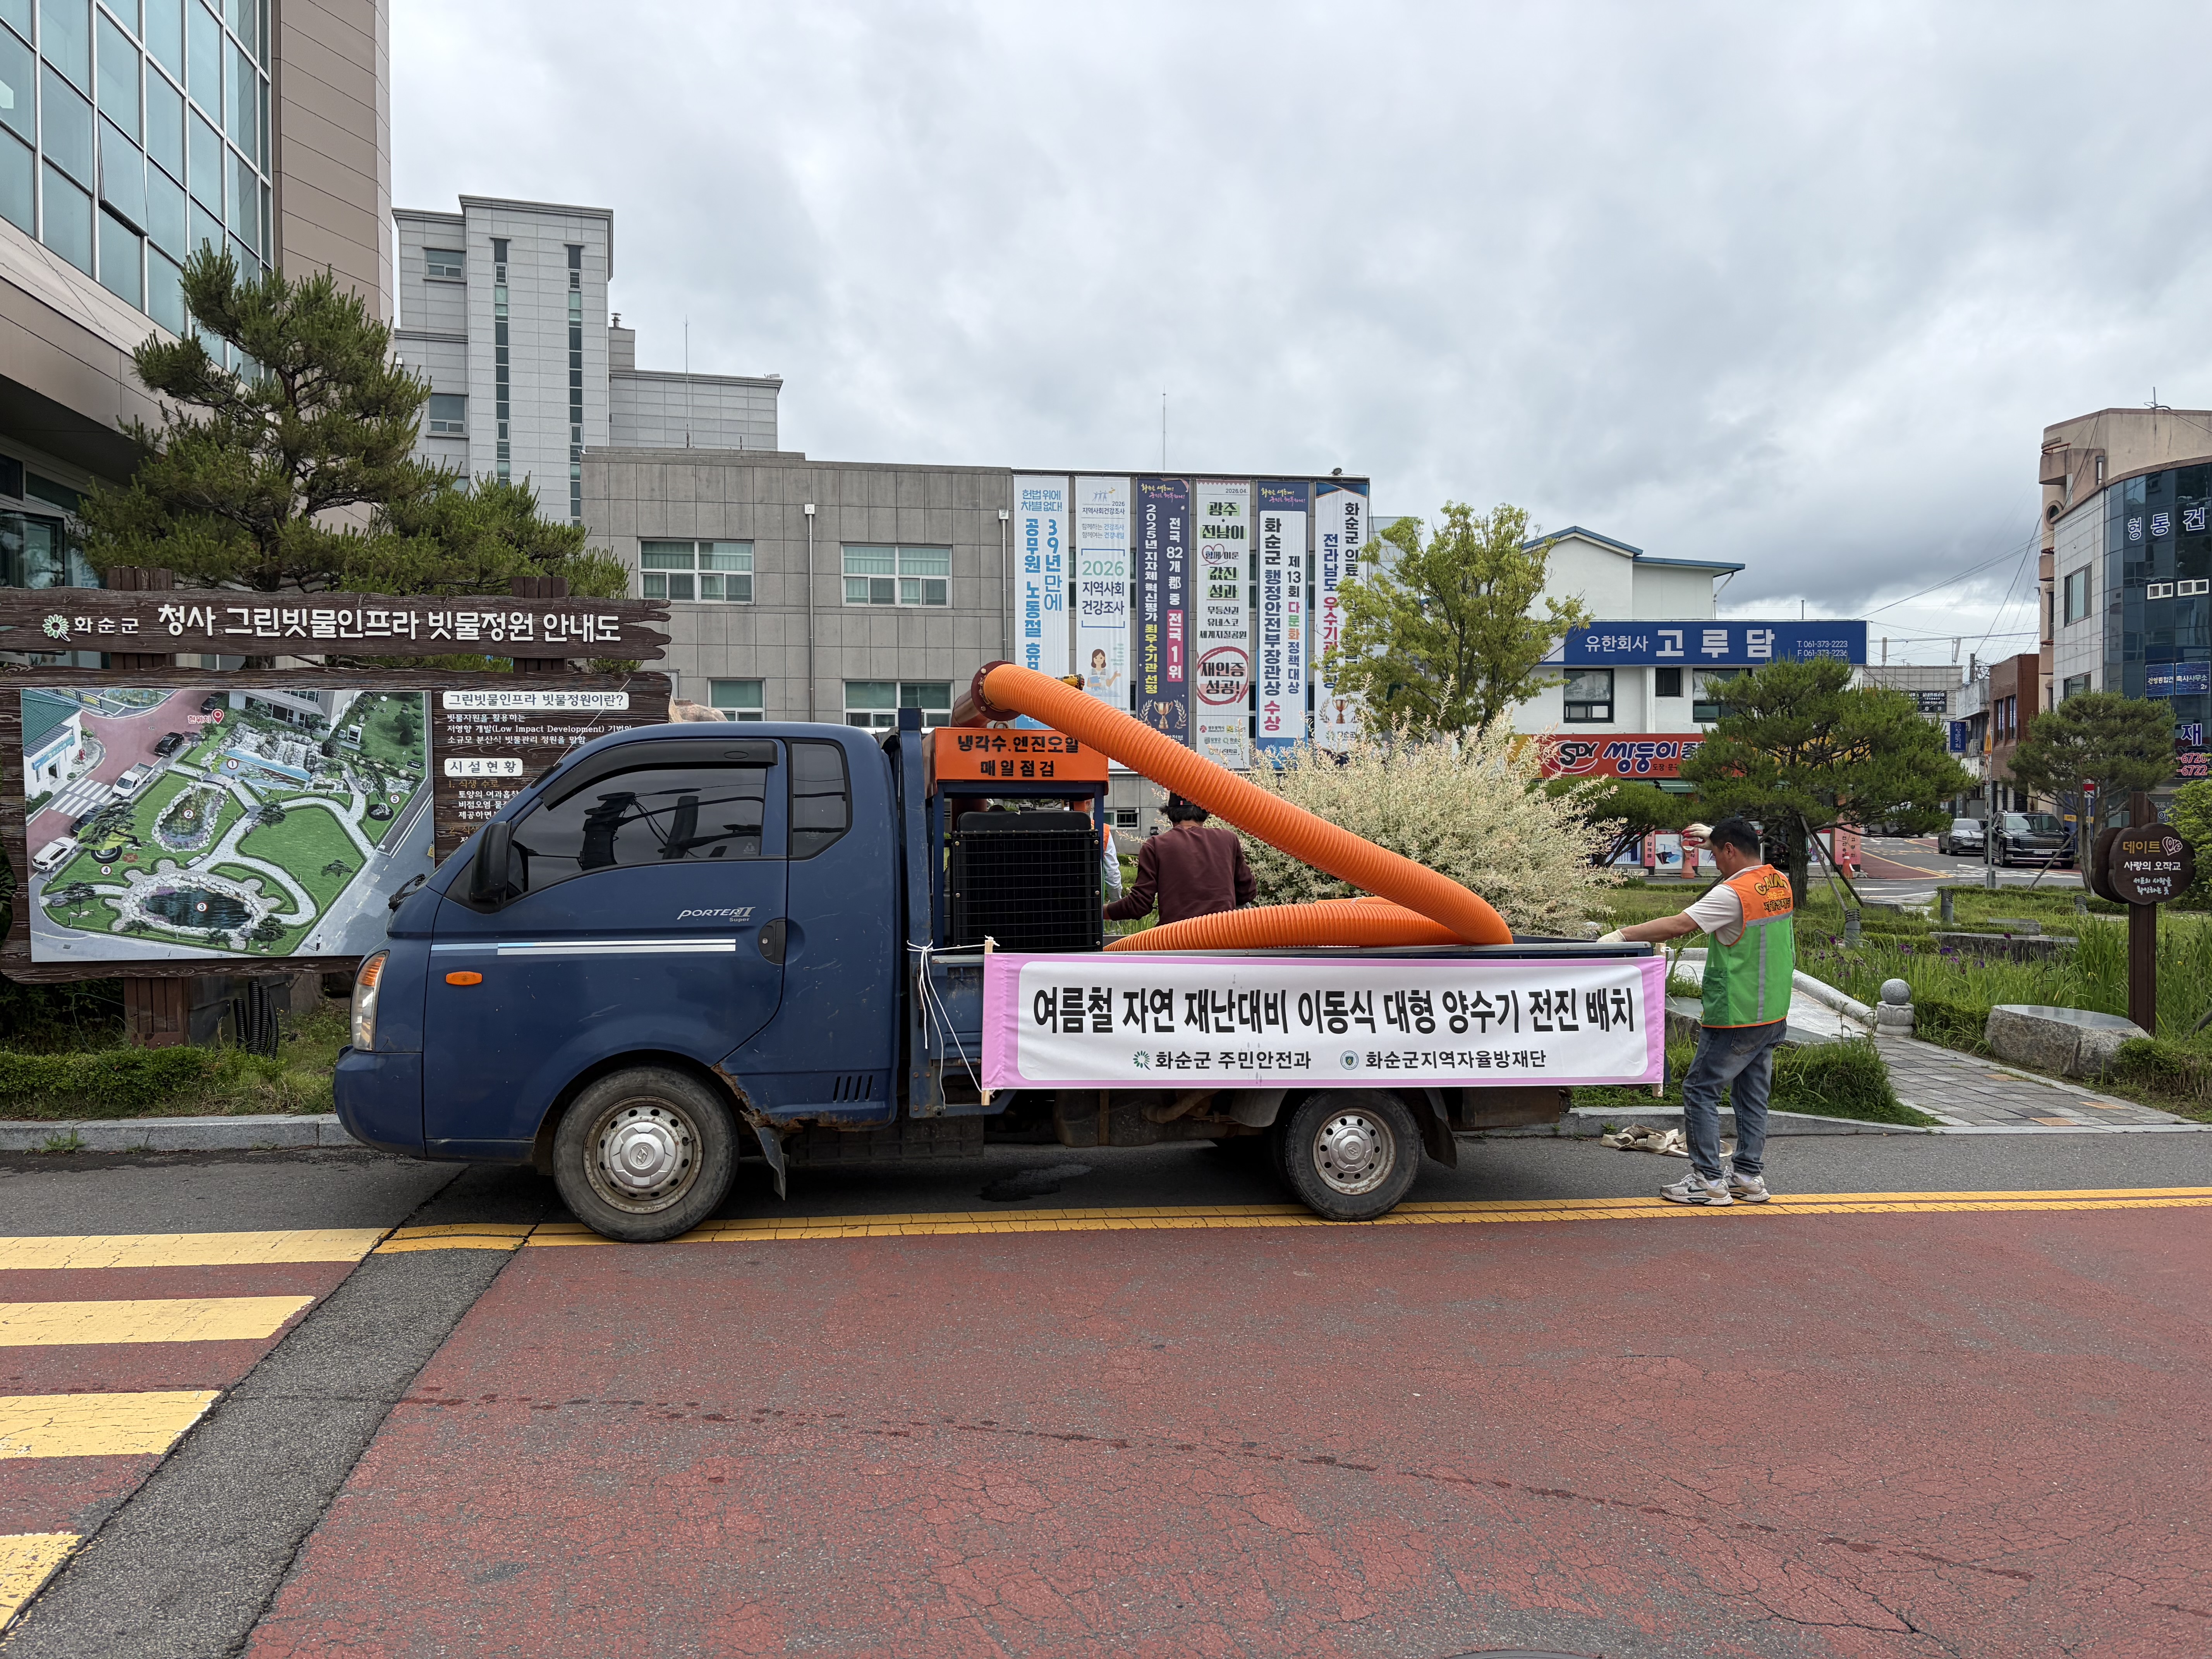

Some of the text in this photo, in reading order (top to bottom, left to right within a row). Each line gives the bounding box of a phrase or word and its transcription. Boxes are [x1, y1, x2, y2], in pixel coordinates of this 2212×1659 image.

[1022, 489, 1061, 500] 헌법 위에
[1021, 501, 1062, 511] 차별 없다!
[1209, 502, 1238, 516] 광주
[1345, 502, 1359, 544] 화순군
[1170, 518, 1180, 543] 전국
[1202, 525, 1244, 539] 전남이
[1025, 519, 1040, 573] 공무원
[1205, 551, 1220, 559] 함께
[1082, 560, 1124, 576] 2026
[1145, 552, 1158, 581] 지자체
[1324, 534, 1339, 591] 전라남도
[1209, 567, 1237, 580] 값진
[1083, 581, 1124, 596] 지역사회
[1209, 585, 1237, 598] 성과
[1145, 583, 1158, 622] 혁신평가
[1170, 593, 1180, 605] 중
[1025, 581, 1041, 637] 노동절
[1082, 600, 1124, 615] 건강조사
[1207, 606, 1239, 615] 무등산권
[74, 604, 621, 643] 화순군 청사 그린빗물인프라 빗물정원 안내도
[1169, 613, 1181, 641] 전국
[1207, 618, 1239, 627] 유네스코
[1264, 517, 1281, 731] 화순군 행정안전부장관상 수상
[1199, 630, 1247, 639] 세계지질공원
[1145, 624, 1158, 672] 최우수기관
[1585, 635, 1649, 652] 유한회사
[1201, 662, 1245, 677] 재인증
[1145, 675, 1158, 694] 선정
[1206, 680, 1240, 694] 성공!
[448, 694, 624, 707] 그린빗물인프라 빗물정원이란?
[187, 715, 211, 724] 현위치
[447, 725, 472, 733] 저영향
[515, 725, 544, 733] Impact
[447, 736, 473, 744] 소규모
[476, 736, 501, 744] 분산식
[505, 736, 538, 744] 빗물관리
[1559, 742, 1599, 766] SDY
[1602, 741, 1678, 773] 쌍둥이
[459, 780, 477, 788] 식생
[481, 780, 500, 788] 수로
[458, 790, 483, 799] 토양의
[458, 801, 491, 809] 비점오염
[2123, 841, 2160, 854] 데이트
[2124, 861, 2181, 871] 사랑의 오작교
[1033, 986, 1635, 1034] 여름철 자연 재난대비 이동식 대형 양수기 전진 배치
[1155, 1051, 1212, 1070] 화순군
[1218, 1051, 1312, 1070] 주민안전과
[1365, 1050, 1547, 1069] 화순군지역자율방재단
